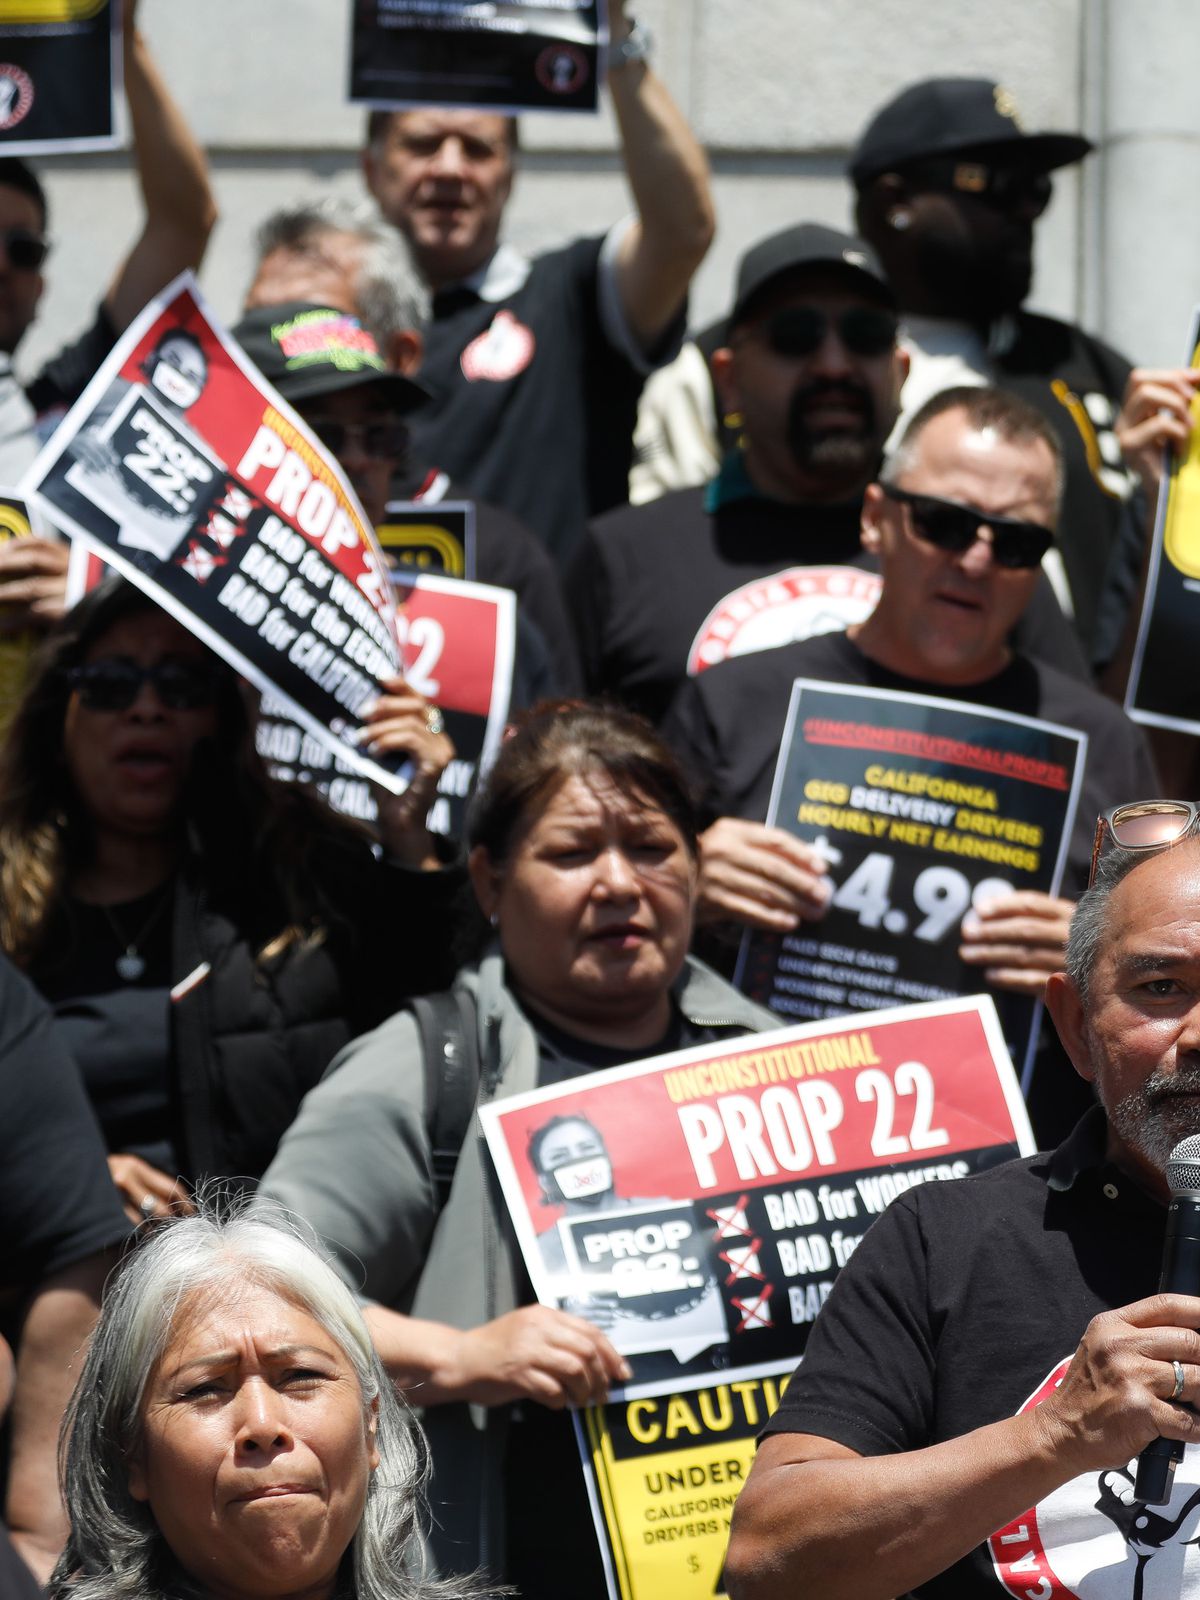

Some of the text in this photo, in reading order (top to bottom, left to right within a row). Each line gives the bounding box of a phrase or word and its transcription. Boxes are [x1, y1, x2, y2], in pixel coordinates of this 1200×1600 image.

[129, 407, 213, 483] PROP
[237, 424, 360, 555] PROP
[258, 515, 307, 564] BAD
[298, 549, 334, 588] for
[217, 573, 270, 627] BAD
[258, 607, 299, 651] for
[239, 542, 401, 683] BAD for the ECON
[803, 779, 1043, 848] GIG DELIVERY DRIVERS
[864, 764, 998, 812] CALIFORNIA
[798, 803, 1040, 873] HOURLY NET EARNINGS
[664, 1031, 881, 1103] UNCONSTITUTIONAL
[677, 1061, 950, 1189] PROP 22
[582, 1220, 693, 1263] PROP
[763, 1188, 820, 1231] BAD
[818, 1185, 858, 1221] for
[776, 1234, 832, 1277] BAD
[627, 1375, 790, 1443] CAUTI
[644, 1493, 738, 1522] CALIFORN
[645, 1459, 744, 1495] UNDER
[643, 1519, 719, 1545] DRIVERS
[686, 1554, 700, 1575] $
